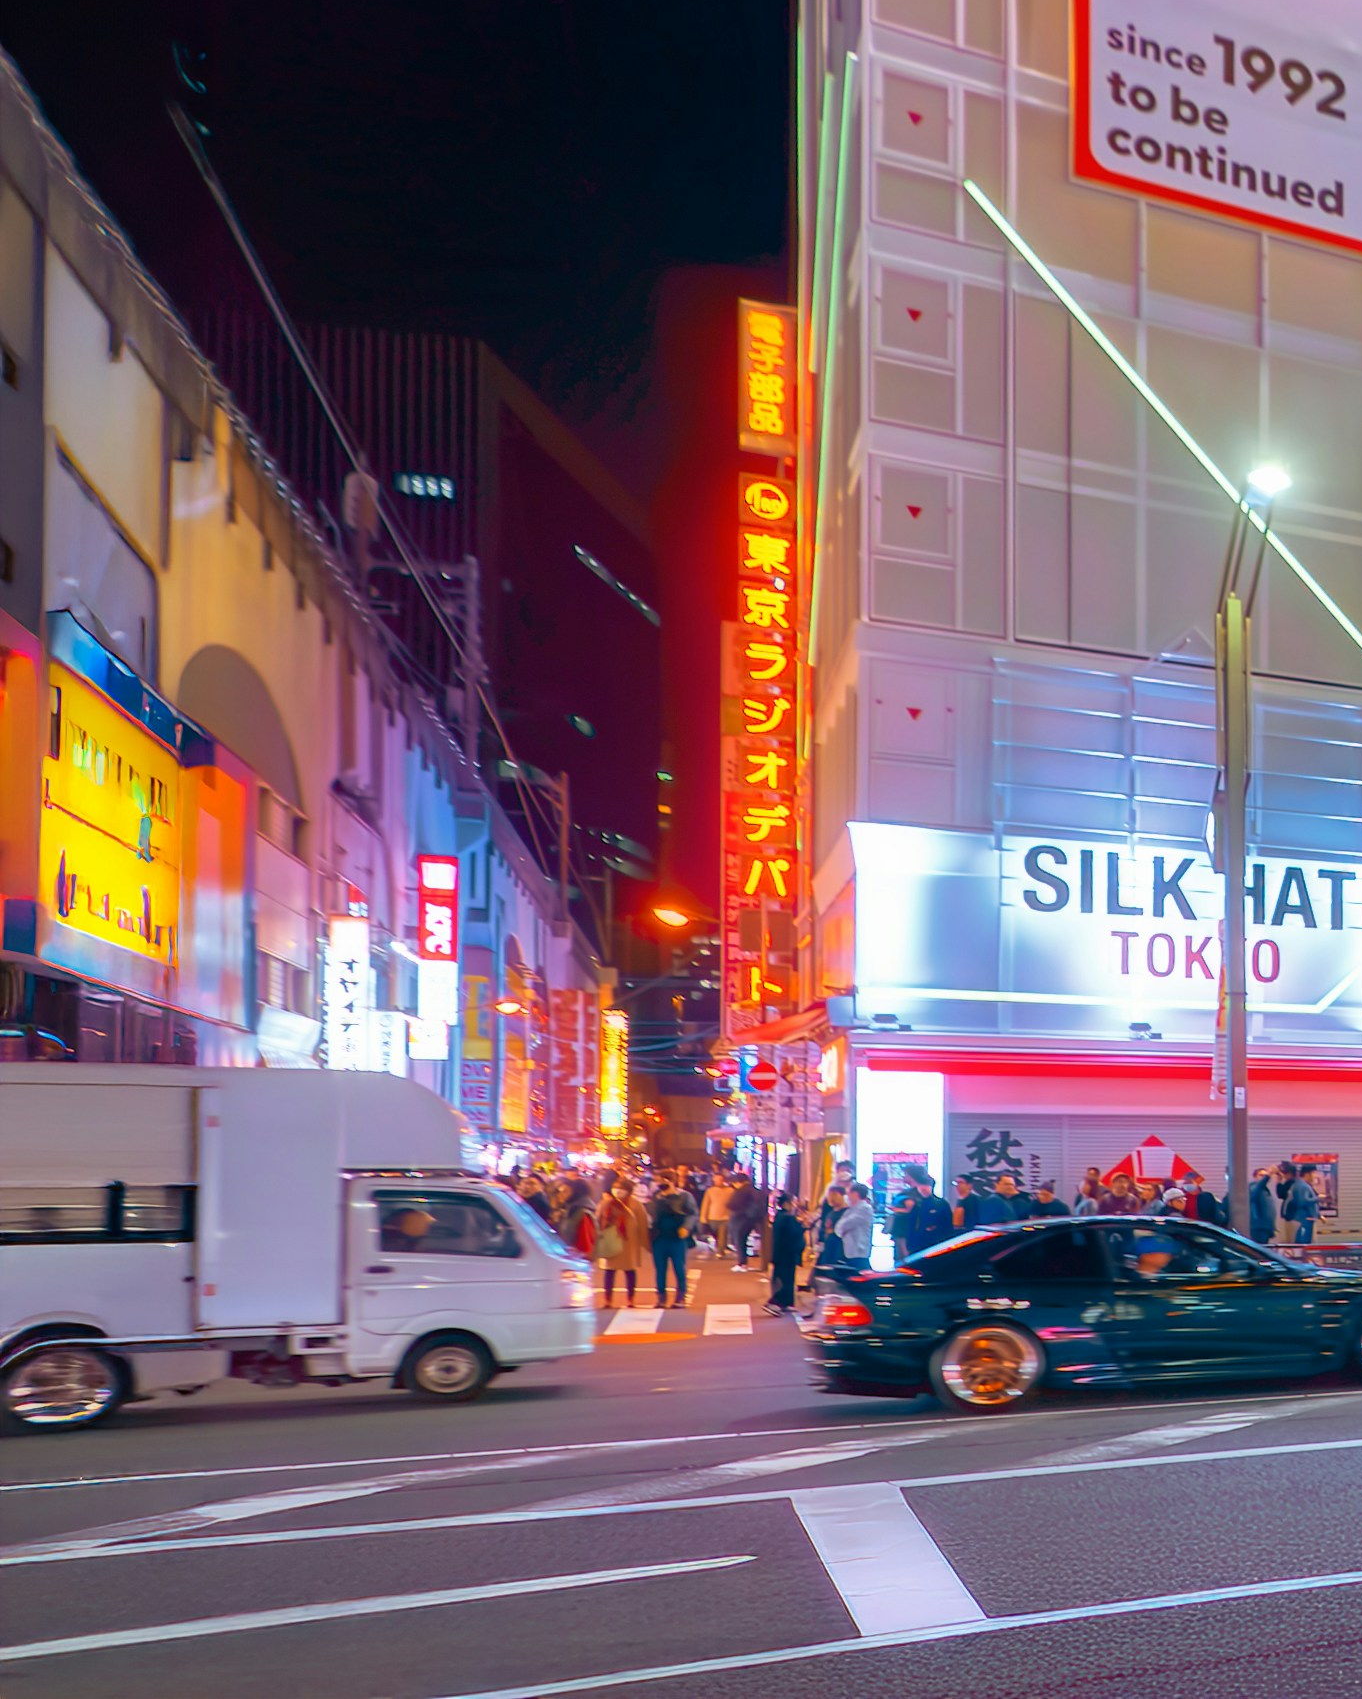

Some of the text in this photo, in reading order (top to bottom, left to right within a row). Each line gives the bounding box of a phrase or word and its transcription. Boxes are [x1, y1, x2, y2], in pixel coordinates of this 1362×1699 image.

[1106, 24, 1347, 120] since 1992
[1106, 71, 1229, 136] to be
[1106, 126, 1344, 217] continued
[743, 533, 790, 1002] 東京ラジオデパト
[1023, 845, 1197, 920] SILK
[1111, 931, 1280, 983] TOKO
